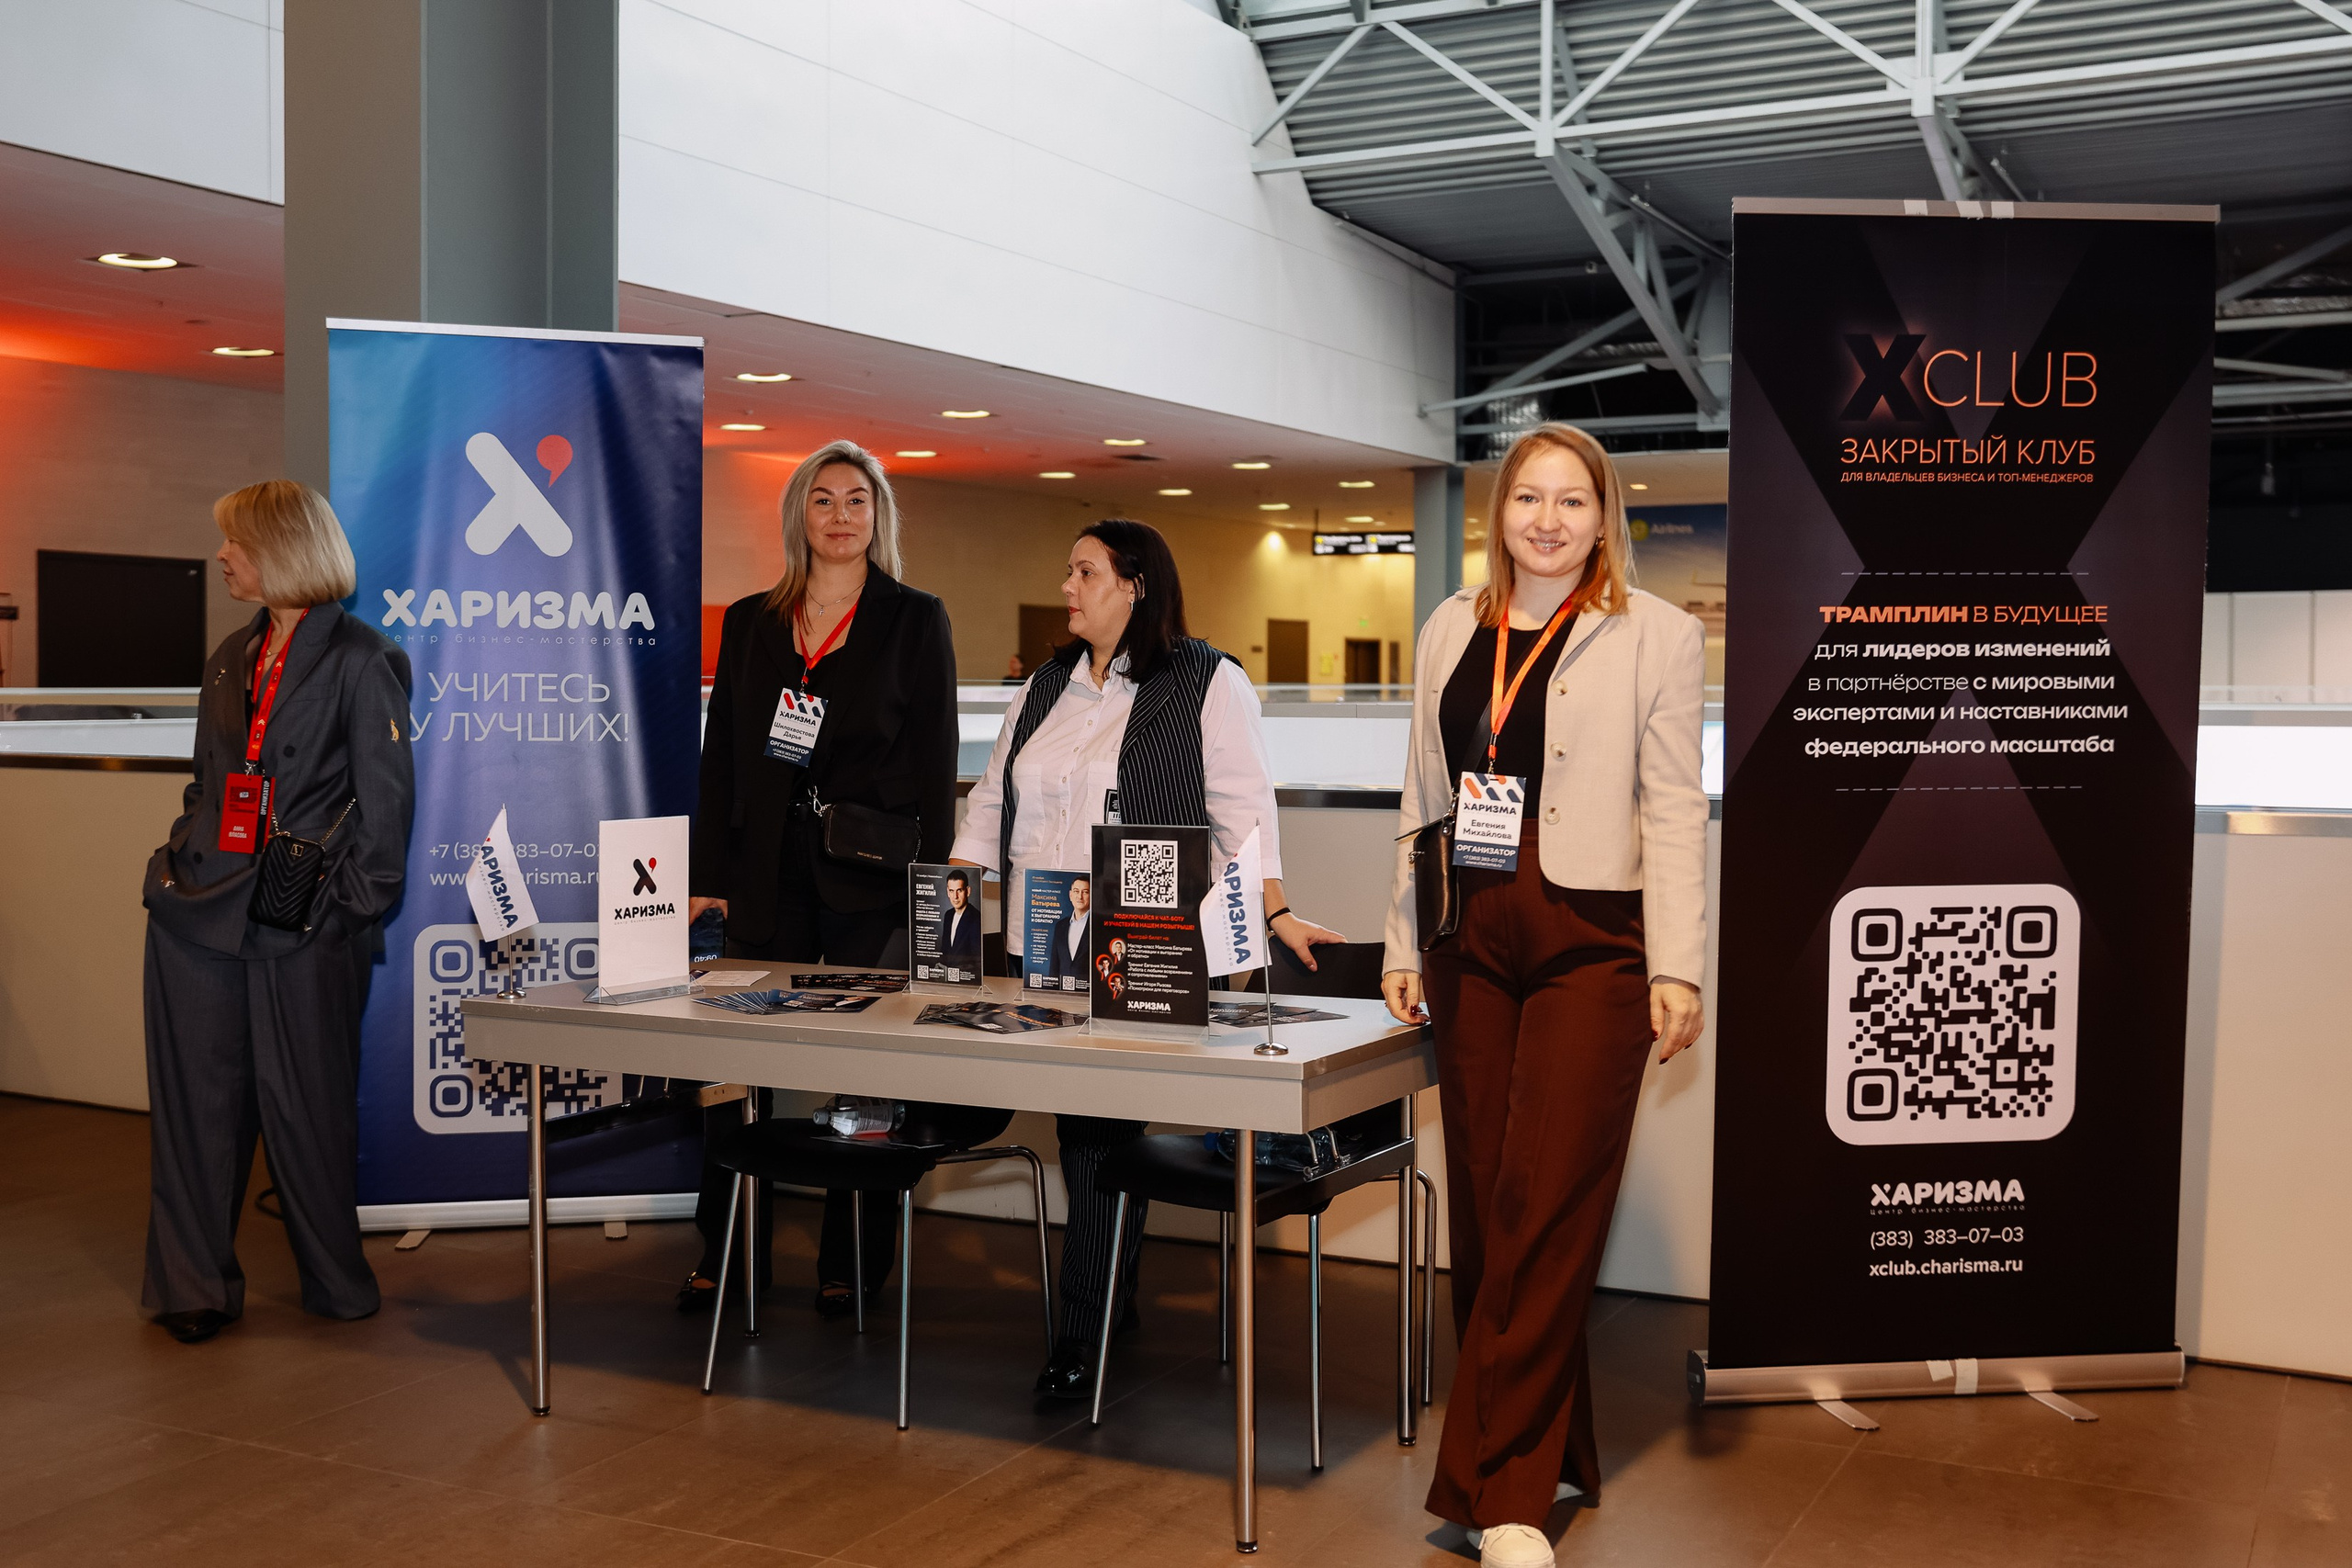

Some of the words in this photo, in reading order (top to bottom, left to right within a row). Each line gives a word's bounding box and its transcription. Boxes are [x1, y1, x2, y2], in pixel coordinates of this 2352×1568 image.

[1840, 434, 2007, 465] ЗАКРЫТЫЙ
[2018, 439, 2096, 465] КЛУБ
[1840, 472, 1863, 483] ДЛЯ
[1865, 472, 1935, 483] ВЛАДЕЛЬЦЕВ
[1937, 473, 1984, 482] БИЗНЕСА
[1987, 473, 1996, 482] И
[1997, 473, 2094, 484] ТОП-МЕНЕДЖЕРОВ
[381, 589, 655, 630] ХАРИЗМА
[1819, 605, 1968, 624] ТРАМПЛИН
[1973, 605, 1988, 623] В
[1994, 605, 2109, 626] БУДУЩЕЕ
[386, 633, 438, 645] ентр
[455, 632, 657, 647] бизнес-мастерства
[1815, 643, 1858, 660] для
[1862, 643, 1970, 660] лидеров
[1974, 638, 2110, 658] изменений
[428, 672, 610, 703] УЧИТЕСЬ
[1807, 677, 1821, 691] в
[1826, 673, 1969, 694] партнёрстве
[1973, 677, 1987, 691] с
[1992, 676, 2115, 693] мировыми
[779, 710, 817, 727] ХАРИЗМА
[1792, 705, 1935, 723] экспертами
[1940, 705, 1955, 720] и
[1960, 705, 2128, 720] наставниками
[410, 713, 433, 742] У
[442, 713, 629, 742] ЛУЧШИХ!
[769, 739, 809, 755] ОРГАНИЗАТОР
[1804, 737, 1985, 758] федерального
[1990, 735, 2115, 754] масштаба
[261, 781, 269, 815] ОРГАНИЗАТОР
[1464, 803, 1517, 815] ХАРИЗМА
[1463, 828, 1512, 840] Михайлова
[1472, 819, 1506, 829] Евгения
[429, 844, 450, 860] +7
[454, 841, 482, 861] (38
[1455, 843, 1516, 857] ОРГАНИЗАТОР
[480, 843, 519, 929] АРИЗМА
[614, 902, 675, 920] ХАРИЗМА
[1224, 862, 1251, 964] АРИЗМА
[1127, 1000, 1171, 1011] ХАРИЗМА
[1871, 1179, 2026, 1206] ХАРИЗМА
[1870, 1230, 1913, 1250] (383)
[1869, 1258, 2023, 1277] xclub.charisma.ru
